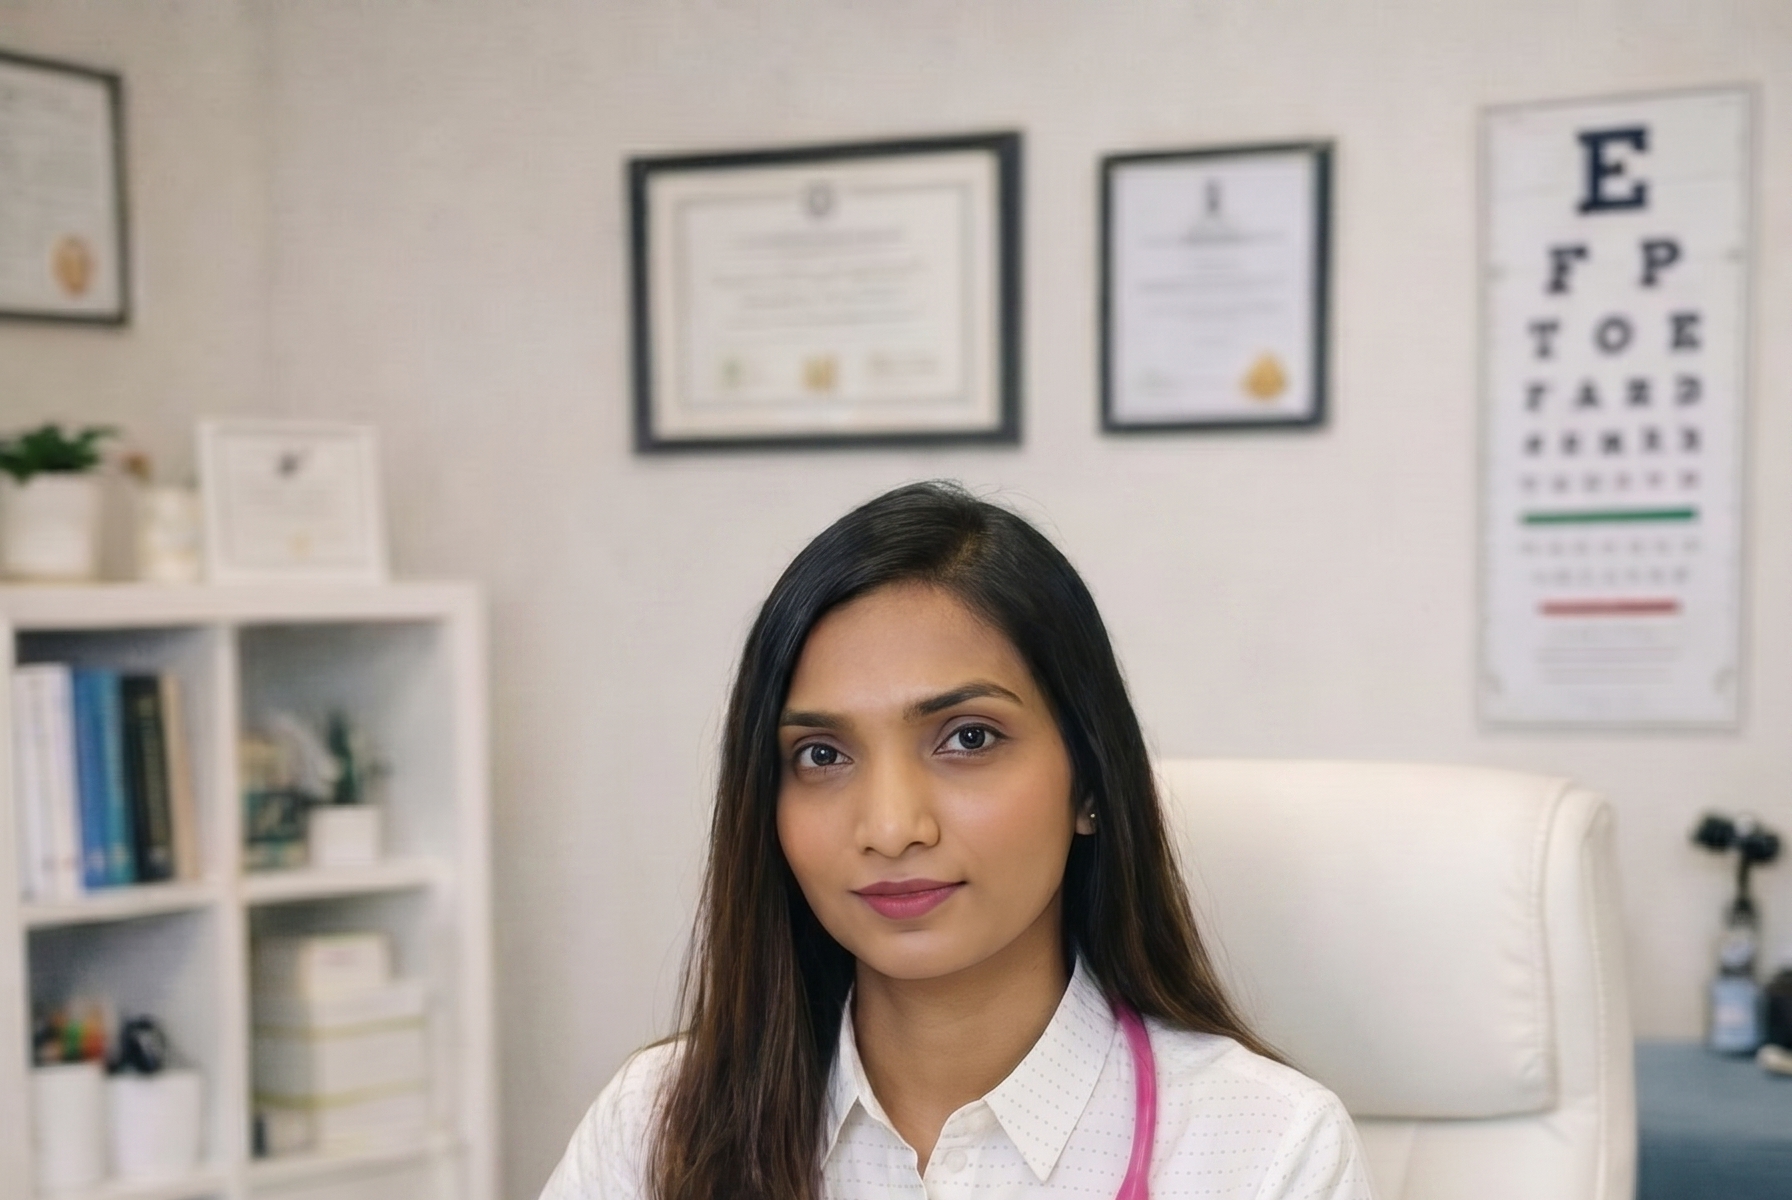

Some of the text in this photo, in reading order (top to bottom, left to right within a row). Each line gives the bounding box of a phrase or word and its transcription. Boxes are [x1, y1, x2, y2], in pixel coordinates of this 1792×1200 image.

[1575, 123, 1650, 217] E
[1545, 236, 1683, 296] F P
[1526, 318, 1562, 361] T
[1591, 313, 1636, 357] O
